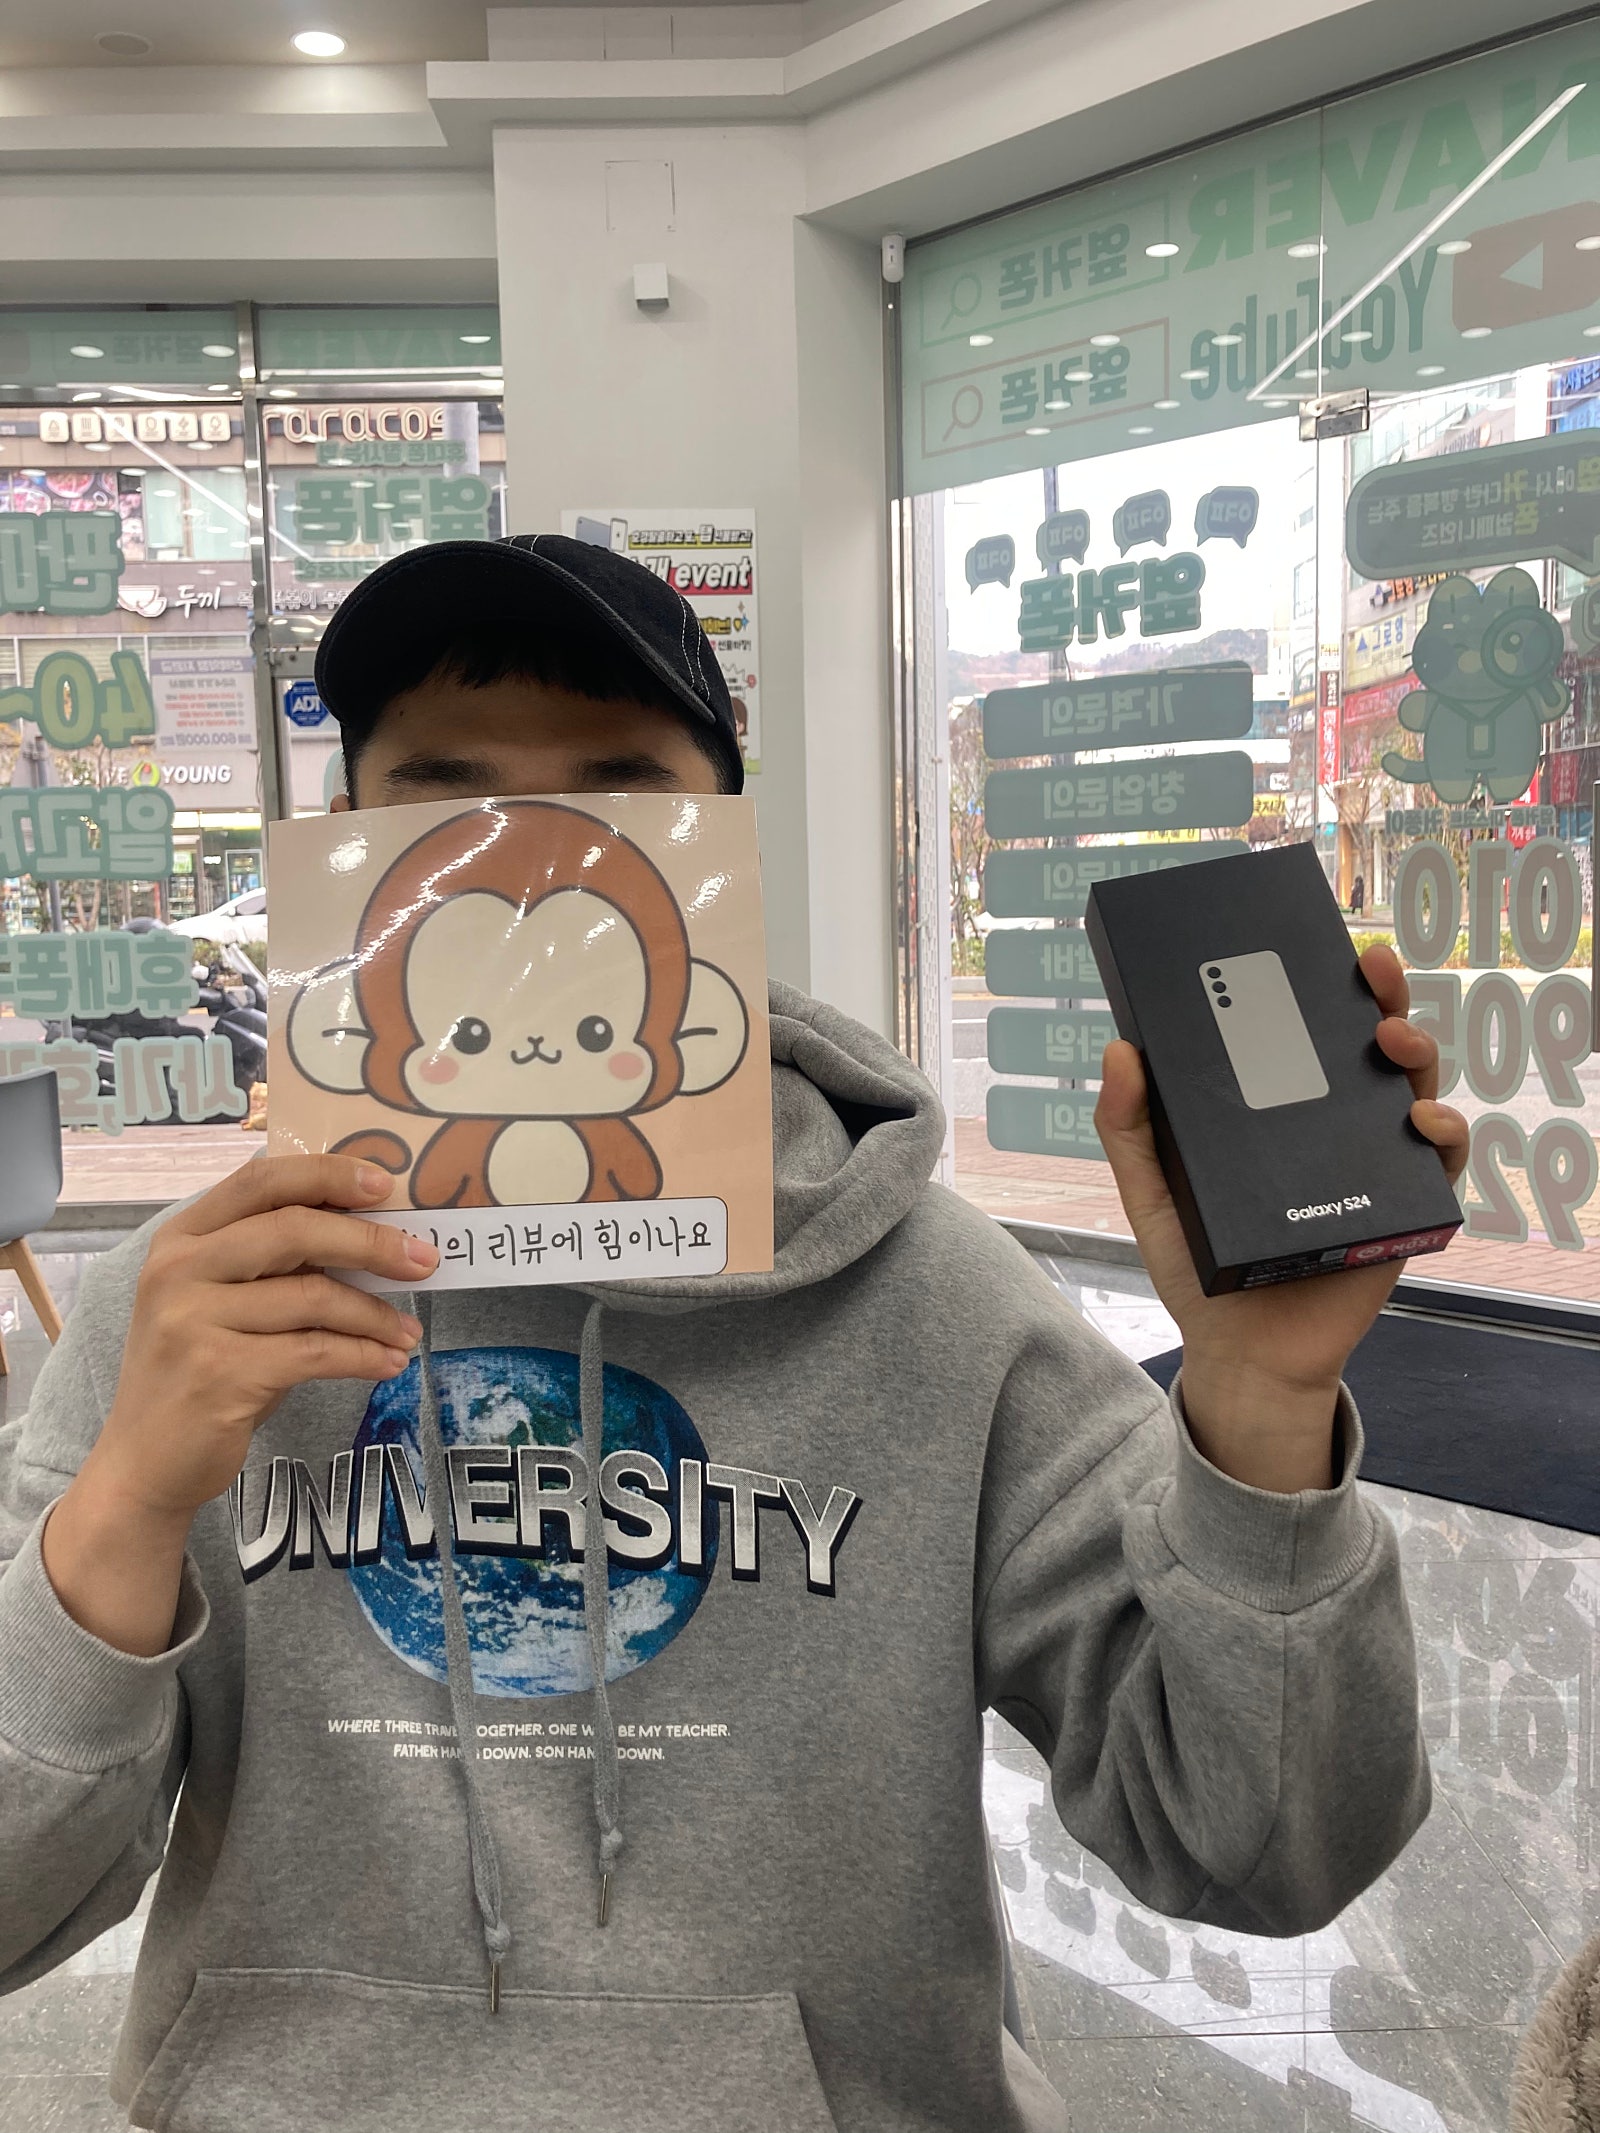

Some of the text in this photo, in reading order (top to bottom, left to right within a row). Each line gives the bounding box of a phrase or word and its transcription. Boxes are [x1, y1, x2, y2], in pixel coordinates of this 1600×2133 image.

[263, 406, 444, 443] raracos
[675, 555, 752, 589] event
[175, 585, 221, 619] 두끼
[292, 695, 321, 713] ADT
[161, 763, 232, 785] YOUNG
[1286, 1194, 1372, 1222] Galaxy S24
[488, 1221, 583, 1266] 리뷰에
[594, 1216, 712, 1261] 힘이나요
[228, 1443, 862, 1598] UNIVERSITY
[327, 1719, 381, 1733] WHERE
[385, 1719, 422, 1735] THREE
[476, 1723, 545, 1738] OGETHER.
[548, 1723, 577, 1737] ONE
[617, 1724, 636, 1738] BE
[638, 1725, 662, 1738] MY
[666, 1724, 731, 1738] TEACHER.
[483, 1747, 532, 1760] DOWN.
[535, 1746, 564, 1759] SON
[617, 1747, 665, 1760] DOWN.
